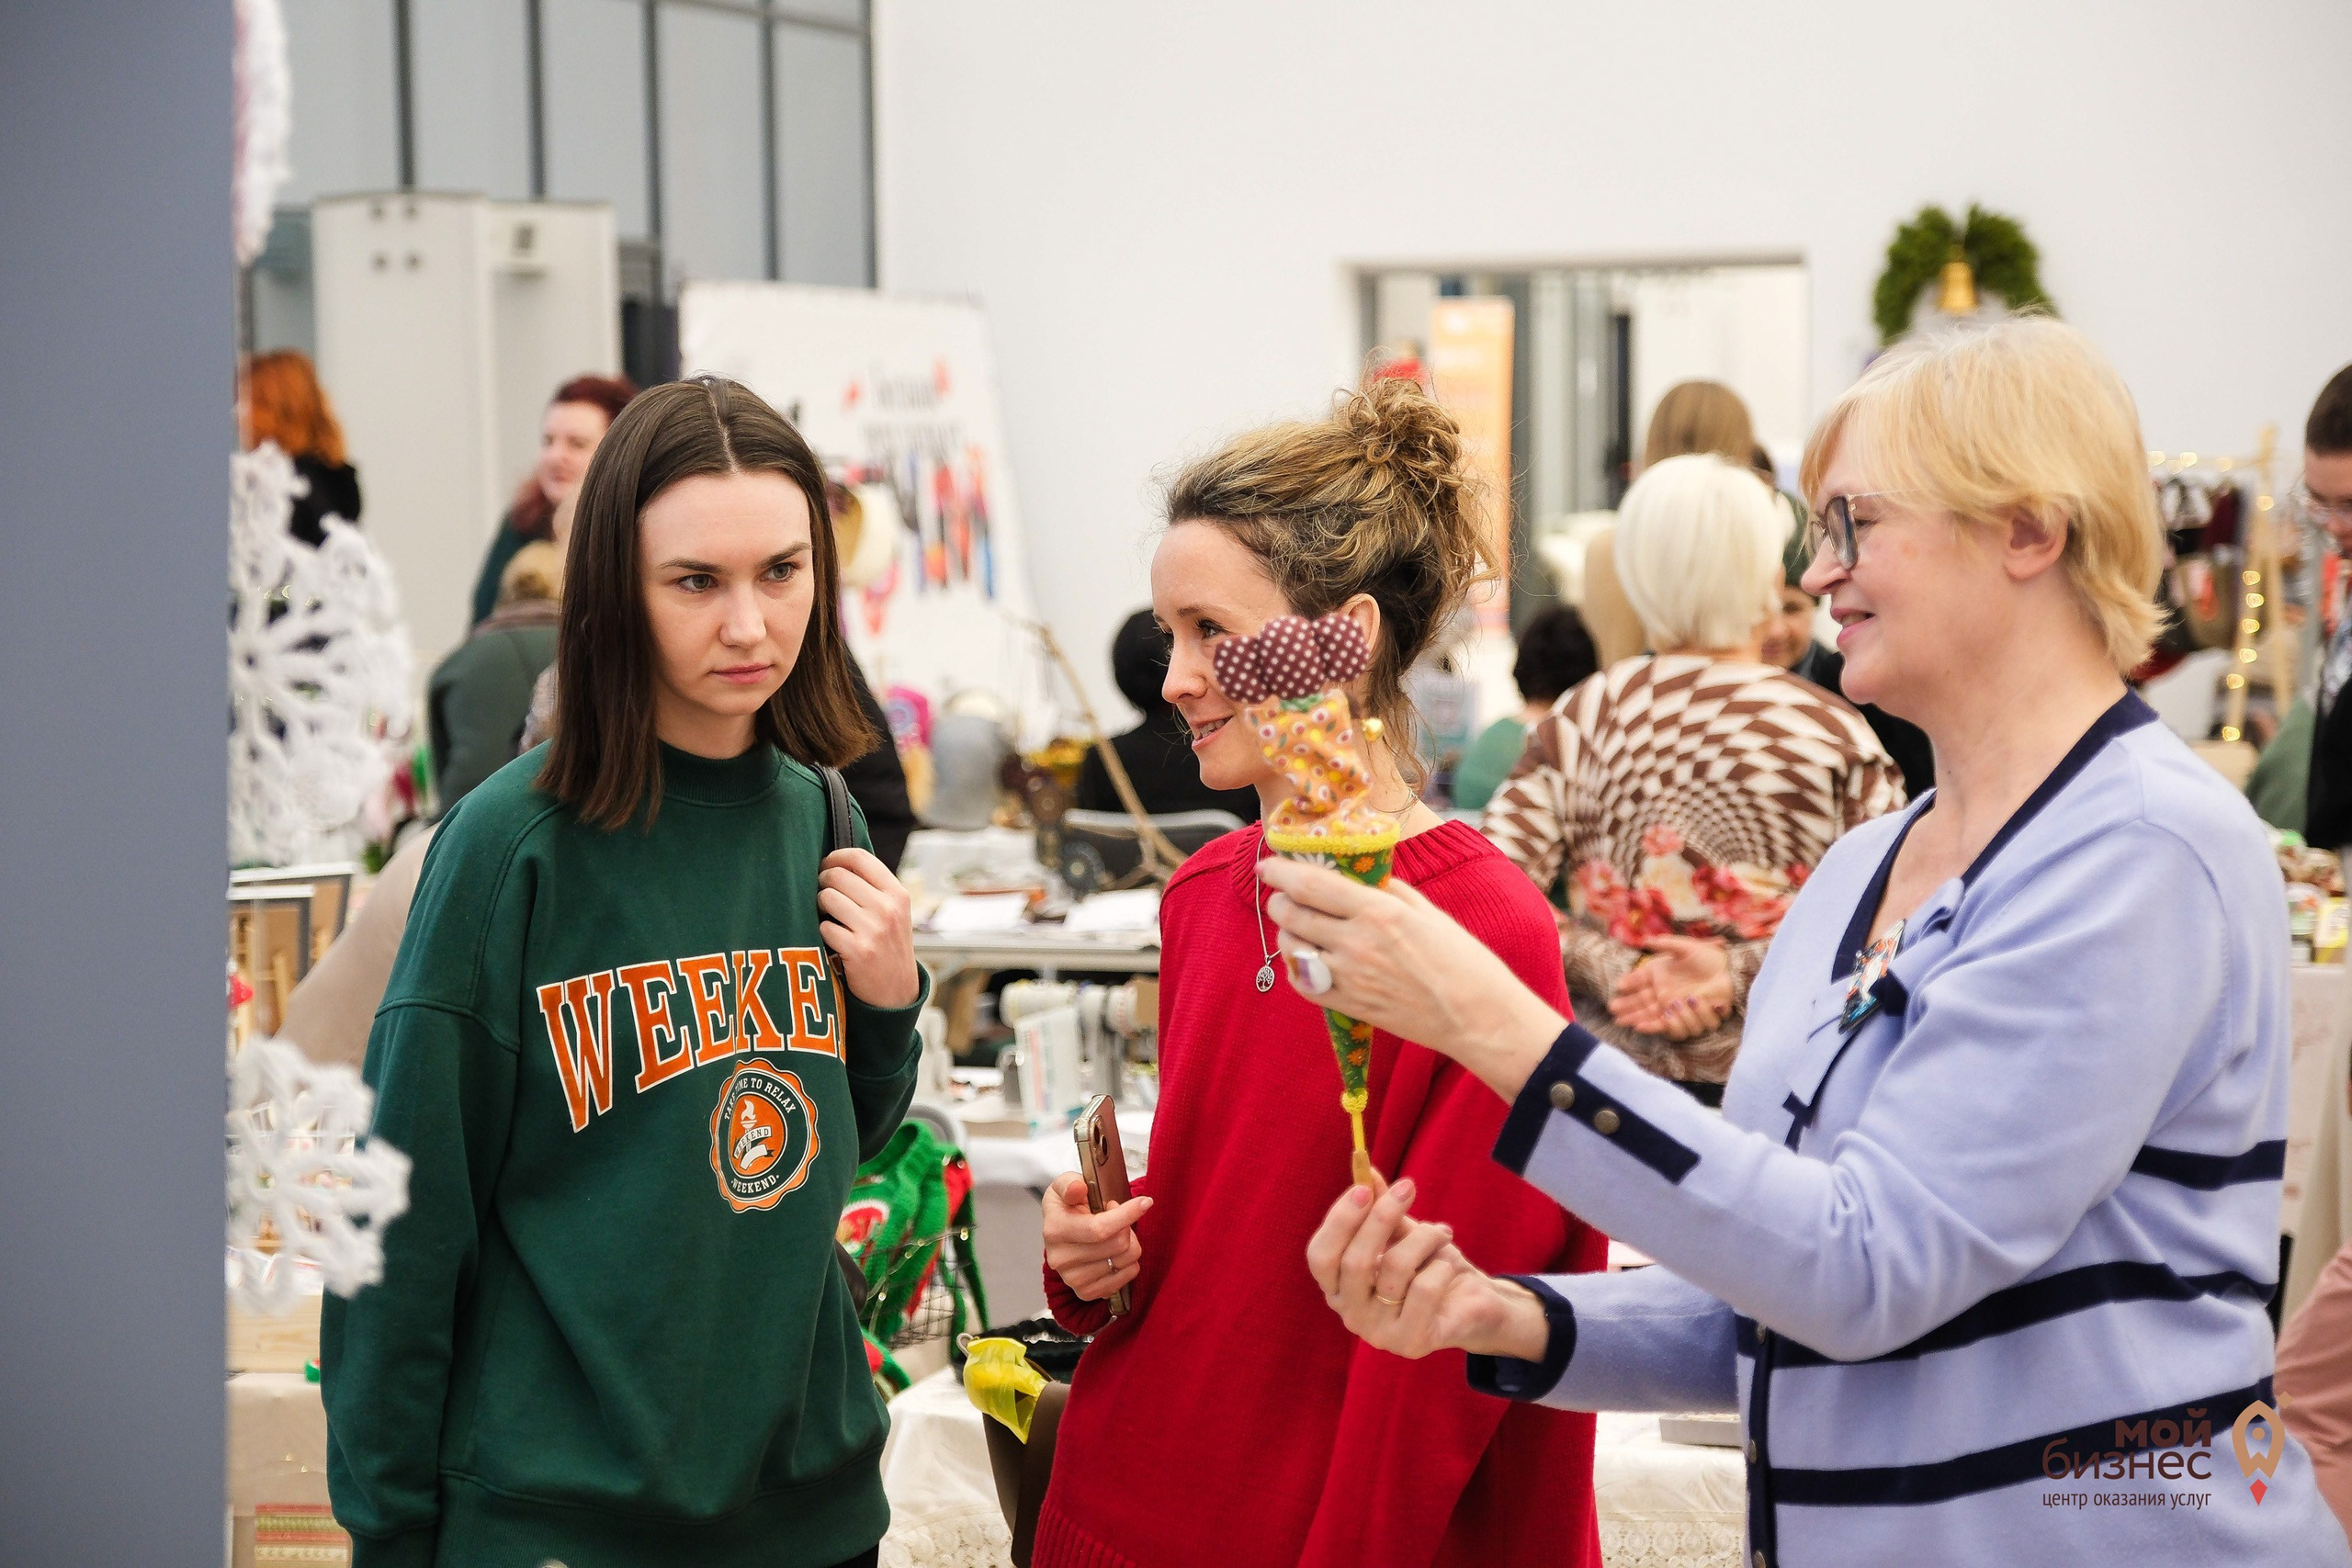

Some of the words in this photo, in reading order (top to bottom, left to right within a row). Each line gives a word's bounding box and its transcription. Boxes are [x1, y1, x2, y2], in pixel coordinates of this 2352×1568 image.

[536, 946, 846, 1134] WEEKE
[751, 1077, 763, 1089] TO
[763, 1081, 797, 1114] RELAX
